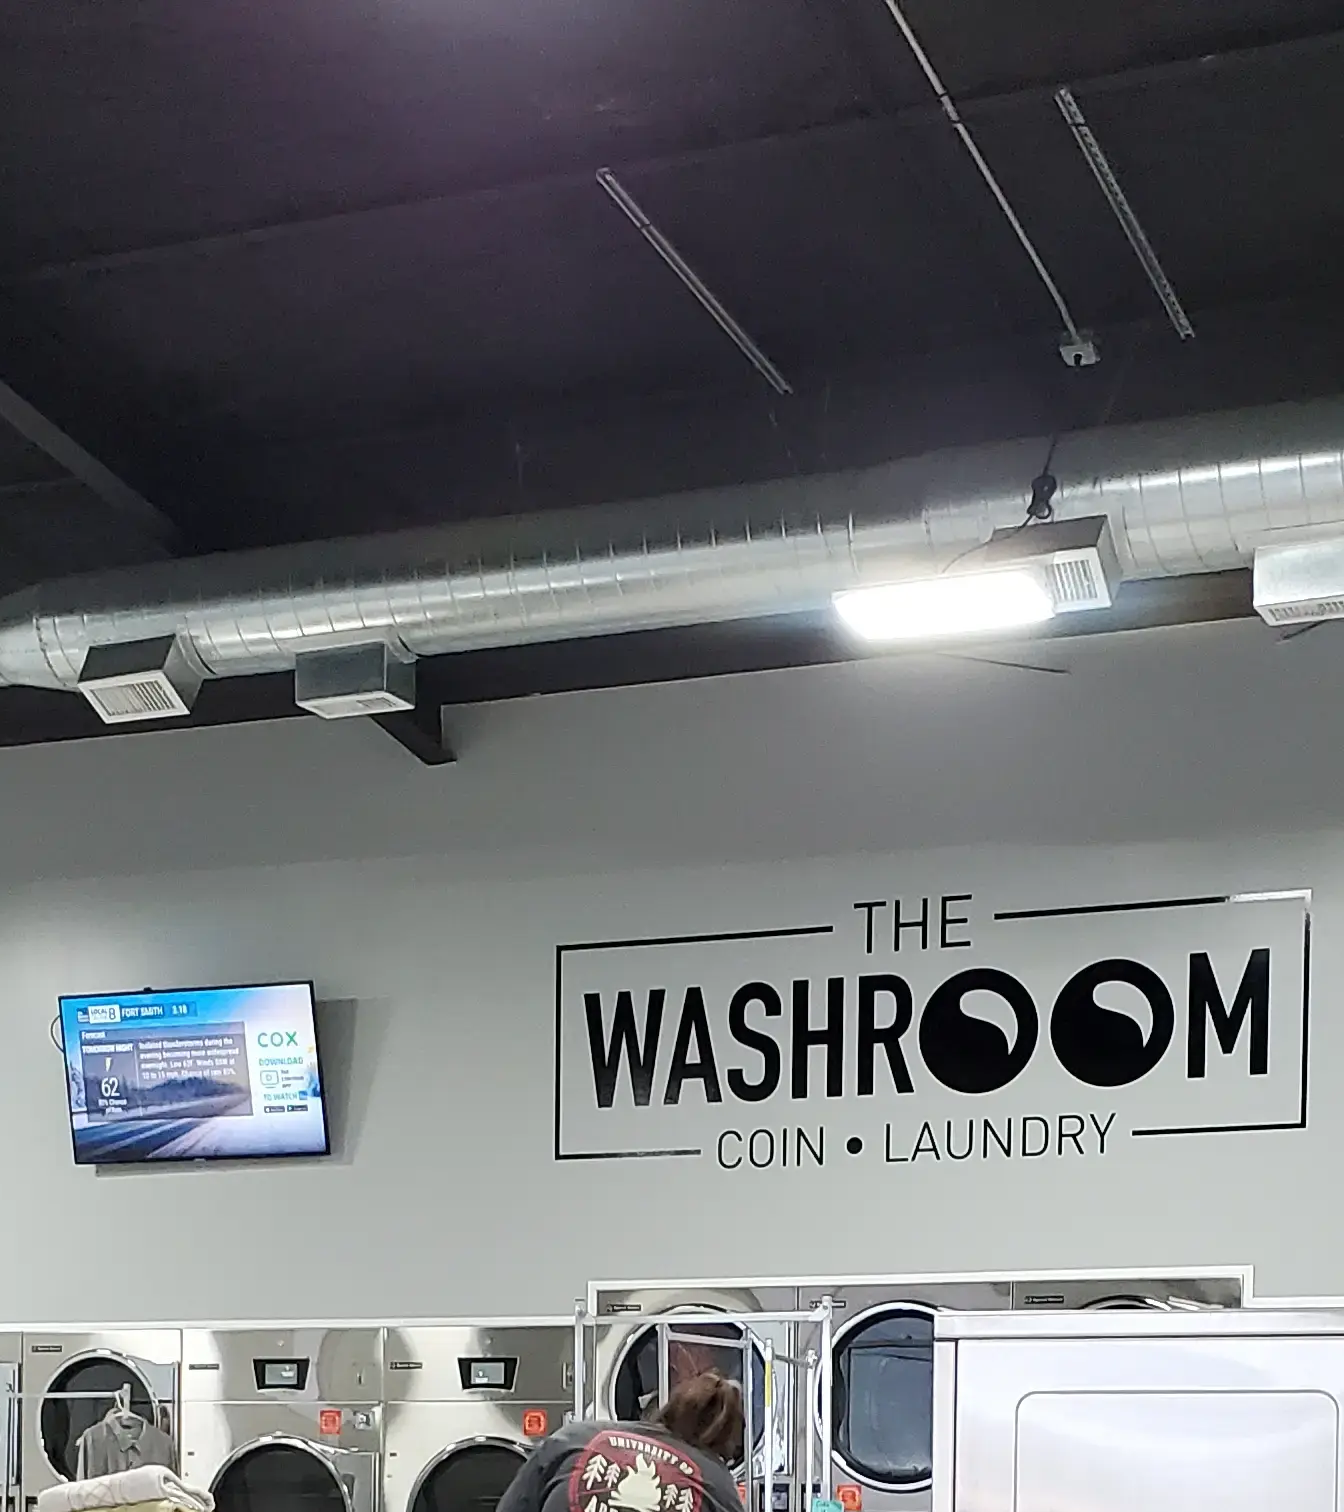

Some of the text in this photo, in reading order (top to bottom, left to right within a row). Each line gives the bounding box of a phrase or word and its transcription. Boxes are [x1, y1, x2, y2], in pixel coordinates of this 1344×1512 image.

[853, 894, 974, 954] THE
[108, 1007, 117, 1020] 8
[121, 1007, 139, 1018] FORT
[140, 1005, 164, 1017] SMITH
[582, 946, 1272, 1110] WASHROOM
[257, 1031, 298, 1048] COX
[258, 1056, 304, 1067] DOWNLOAD
[100, 1076, 121, 1098] 62
[272, 1092, 298, 1101] WATCH
[716, 1112, 1117, 1170] COIN LAUNDRY
